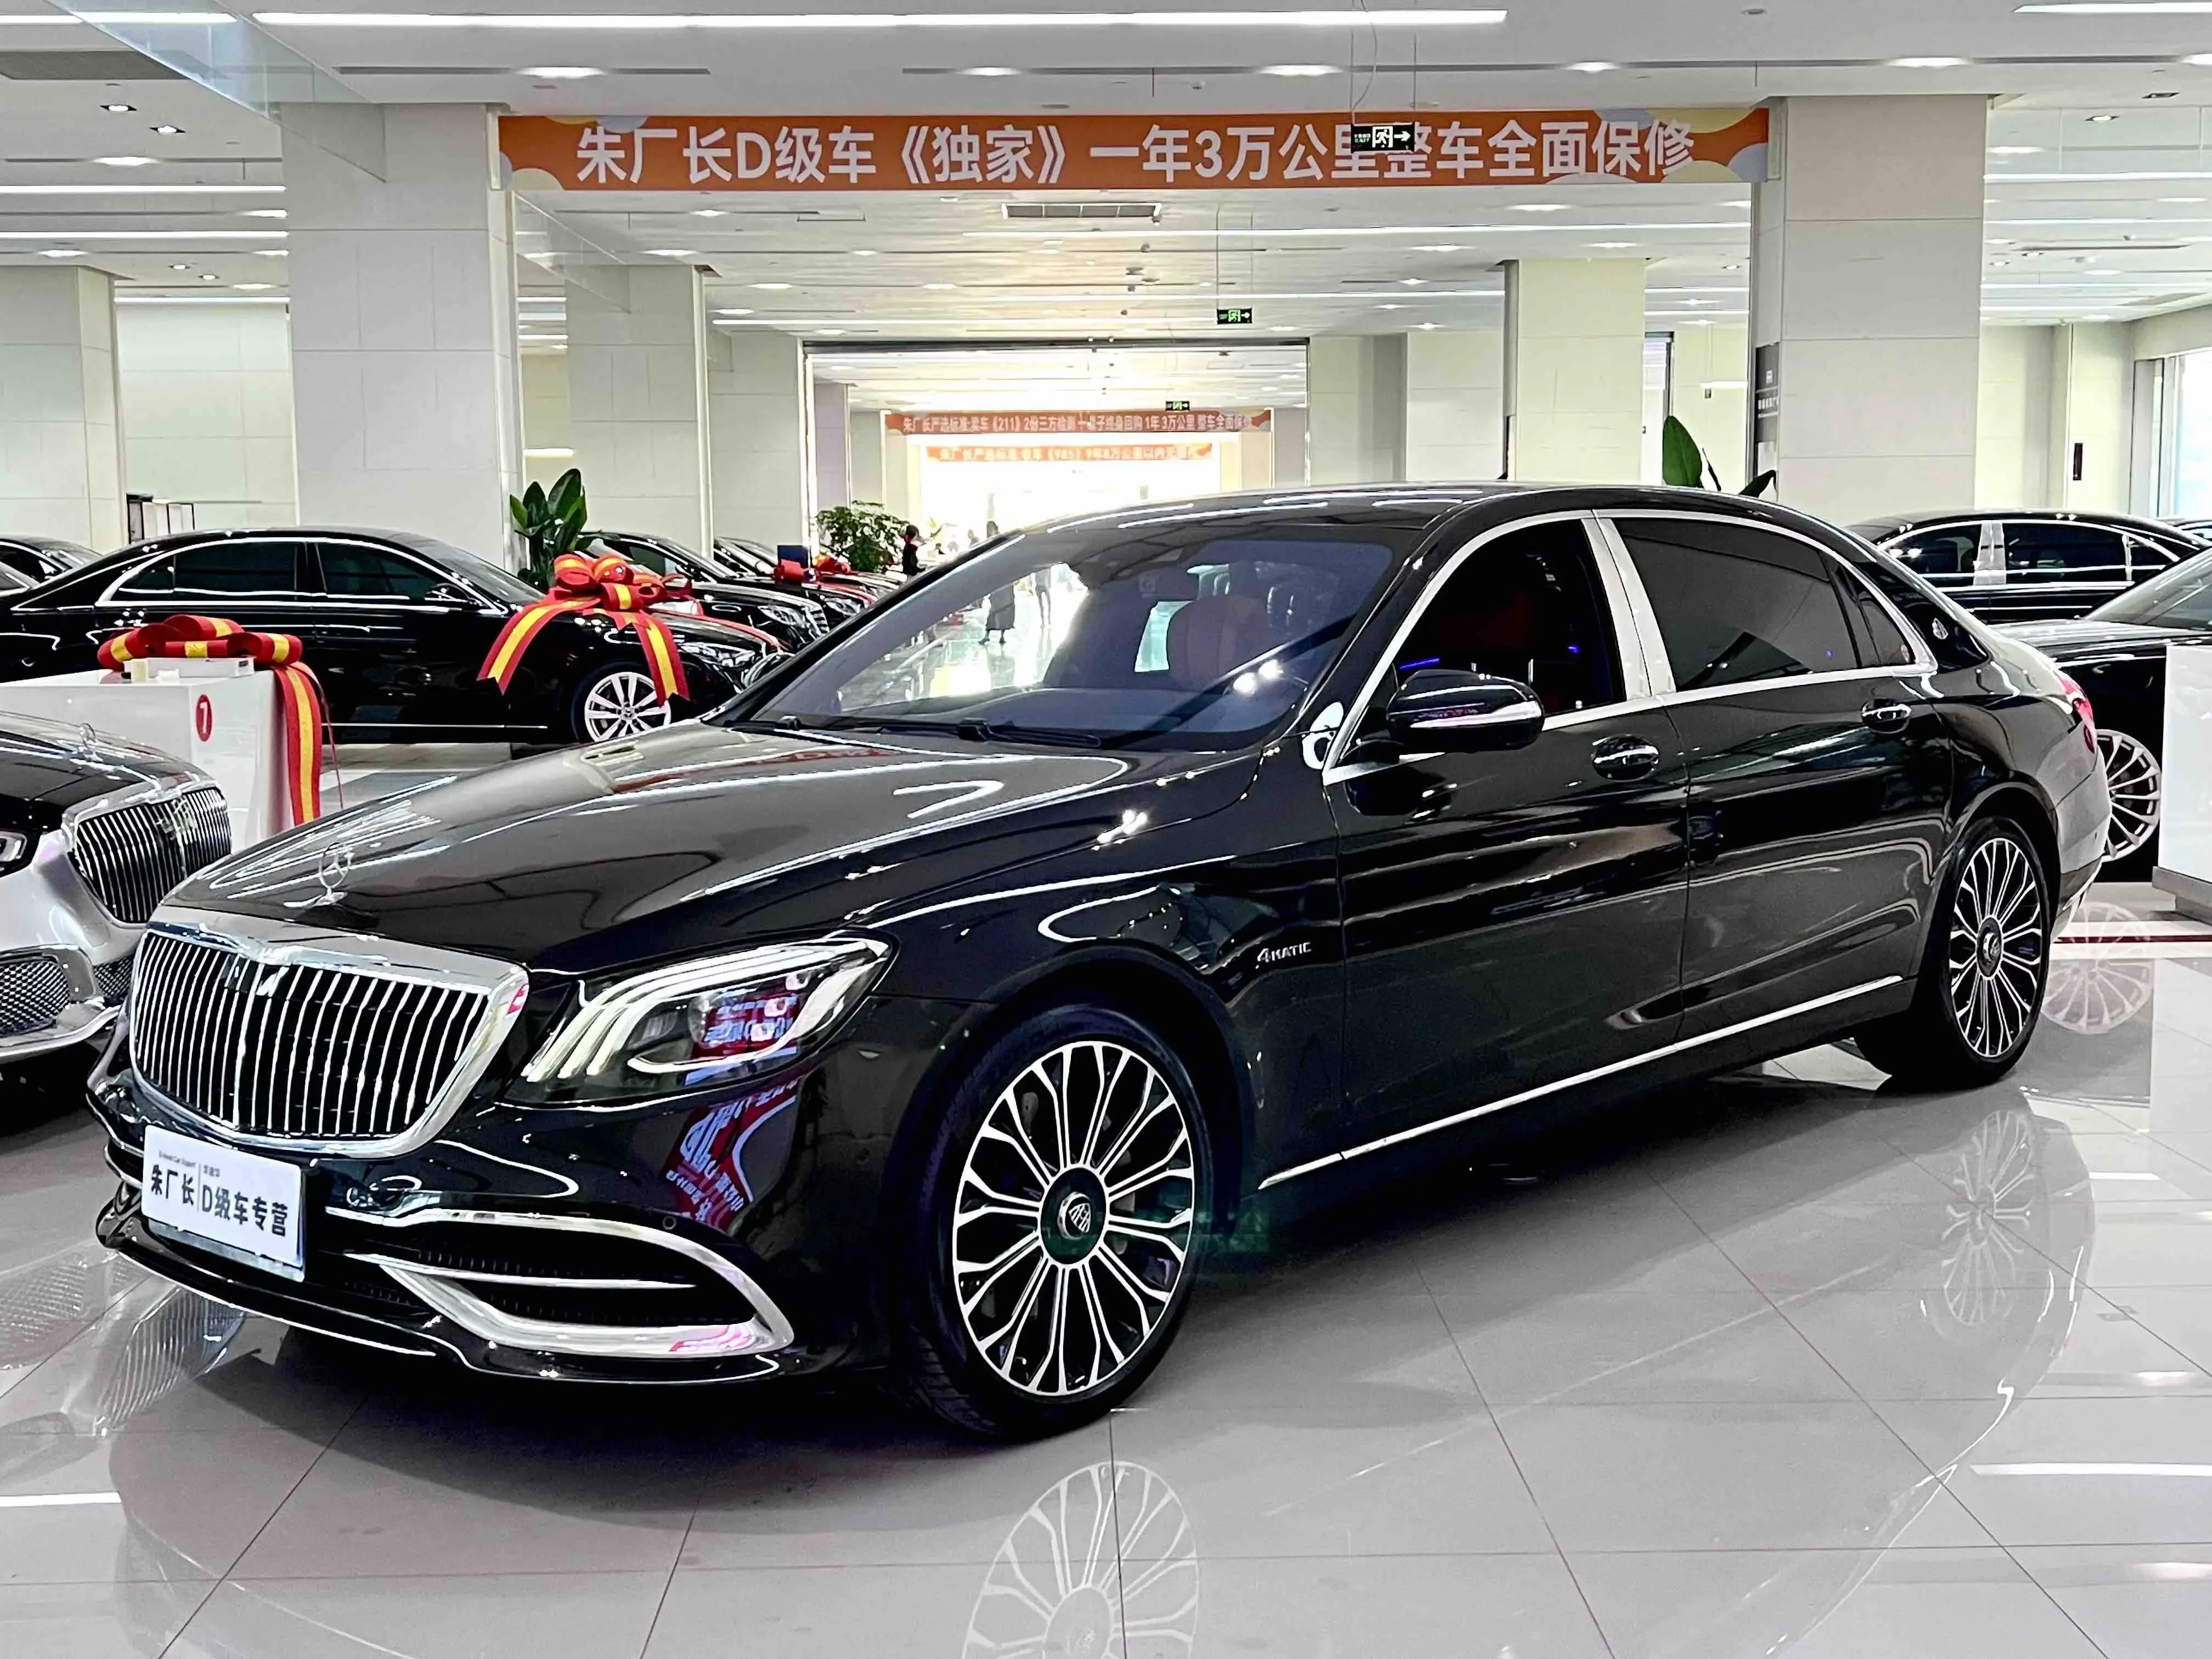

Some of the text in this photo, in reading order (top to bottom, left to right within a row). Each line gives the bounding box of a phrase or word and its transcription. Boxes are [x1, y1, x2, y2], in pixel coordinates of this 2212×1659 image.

[151, 1164, 288, 1237] 朱厂长 D级车专营
